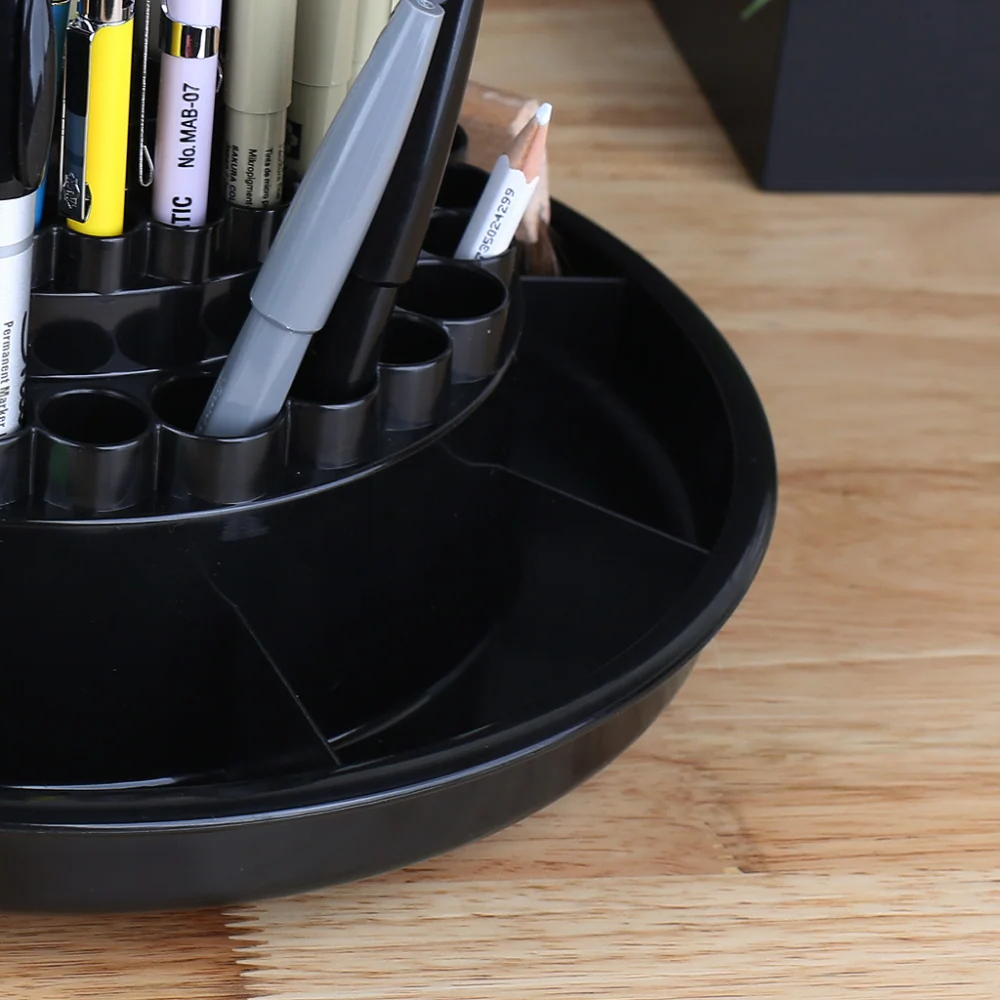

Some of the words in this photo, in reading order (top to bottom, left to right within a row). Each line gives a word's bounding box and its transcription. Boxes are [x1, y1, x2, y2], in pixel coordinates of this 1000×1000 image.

[230, 145, 239, 182] SAKURA
[171, 196, 193, 227] TIC
[0, 320, 14, 384] Permanent
